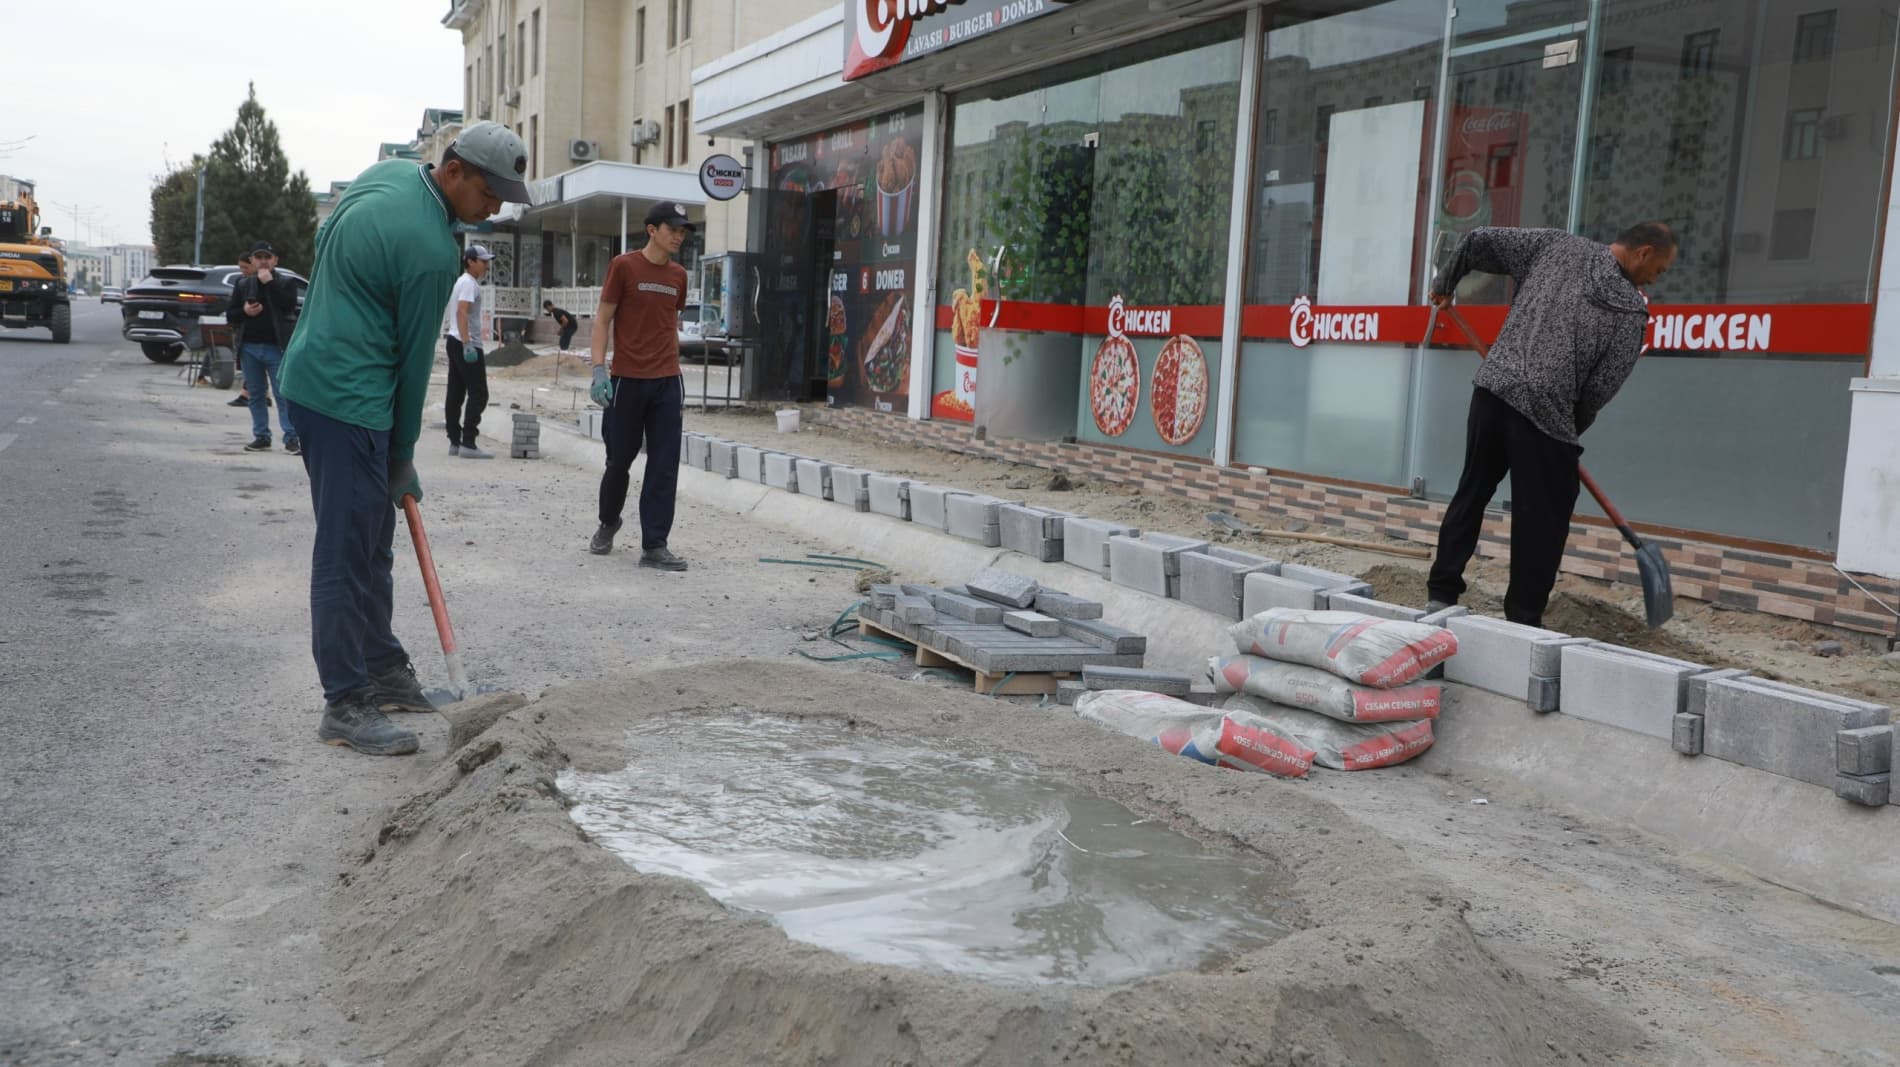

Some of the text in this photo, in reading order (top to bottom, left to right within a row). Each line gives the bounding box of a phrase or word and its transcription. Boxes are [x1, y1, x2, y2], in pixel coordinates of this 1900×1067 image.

[907, 28, 942, 55] LAVASH
[949, 11, 993, 41] BURGER
[862, 272, 868, 289] 6
[876, 269, 905, 290] DONER
[1108, 295, 1171, 338] CHICKEN
[1290, 296, 1379, 347] CHICKEN
[1643, 312, 1772, 351] HICKEN
[1393, 655, 1418, 677] EMENT
[1365, 701, 1391, 711] CESAM
[1391, 700, 1421, 710] CEMENT
